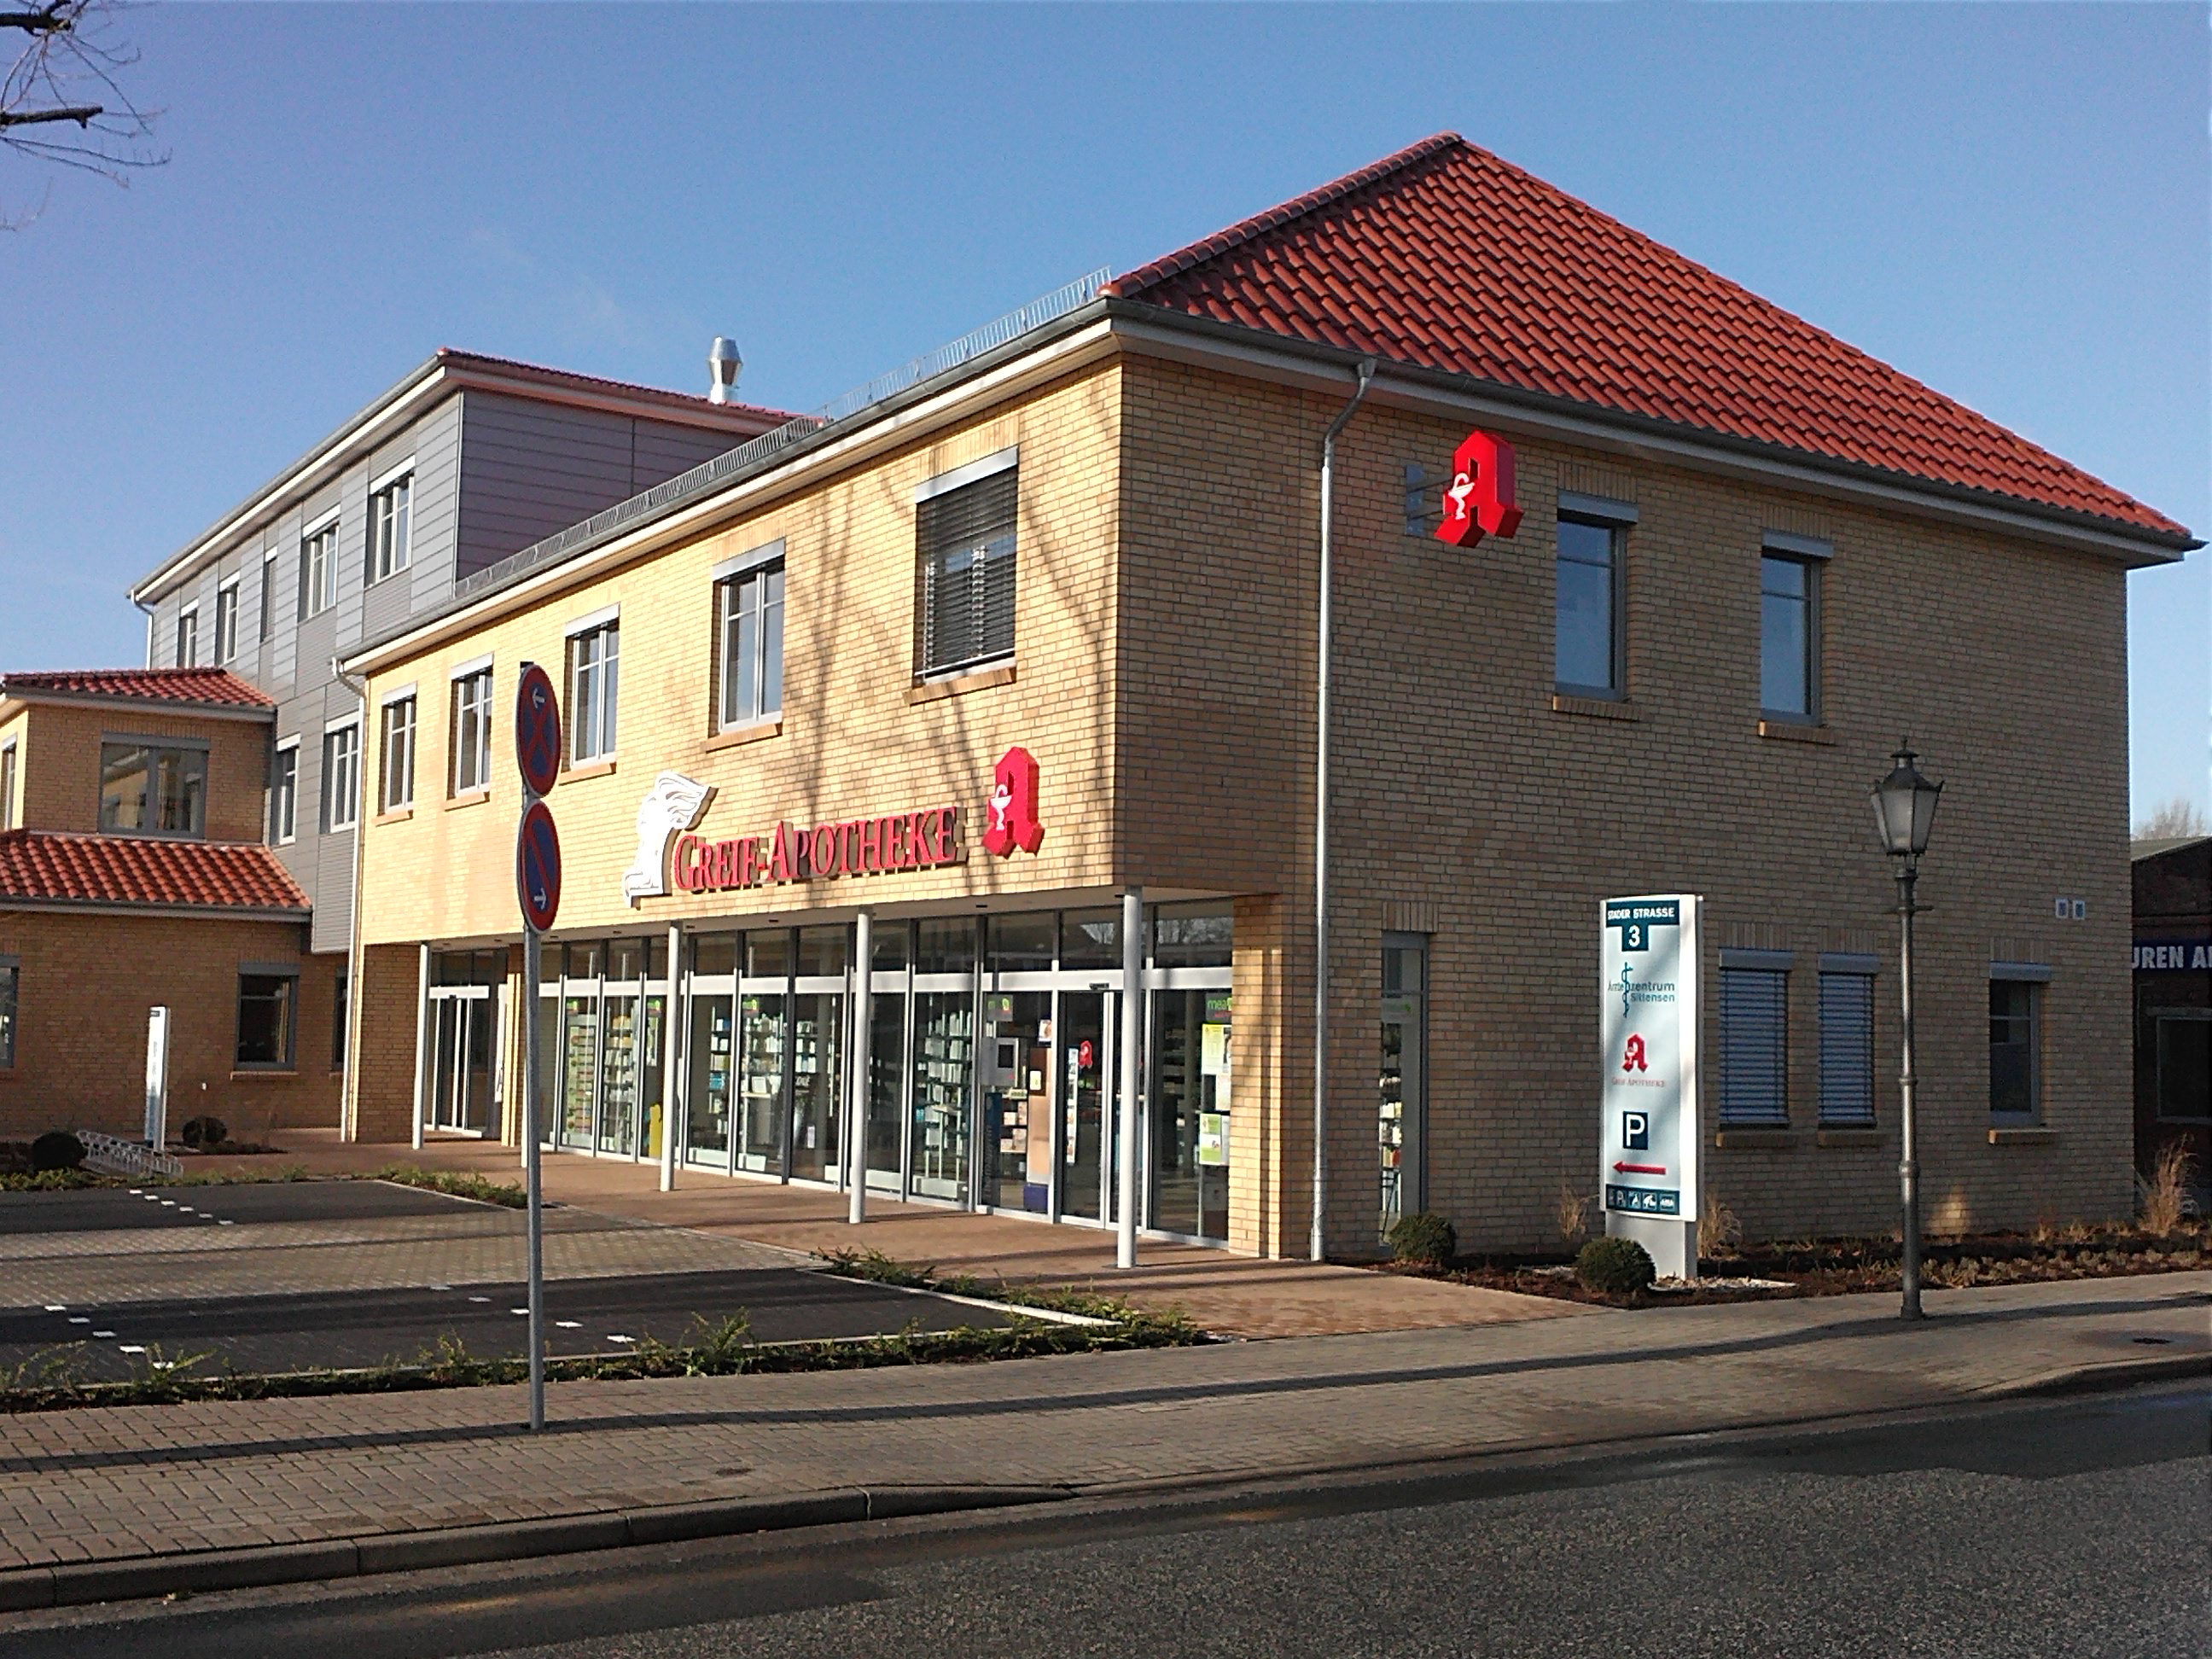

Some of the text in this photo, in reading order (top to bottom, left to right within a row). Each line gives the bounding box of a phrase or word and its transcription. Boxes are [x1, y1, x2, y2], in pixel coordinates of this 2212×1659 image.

[674, 806, 958, 891] GREIF-APOTHEKE
[1633, 907, 1675, 919] STRASSE
[1628, 925, 1640, 946] 3
[1626, 1114, 1645, 1147] P
